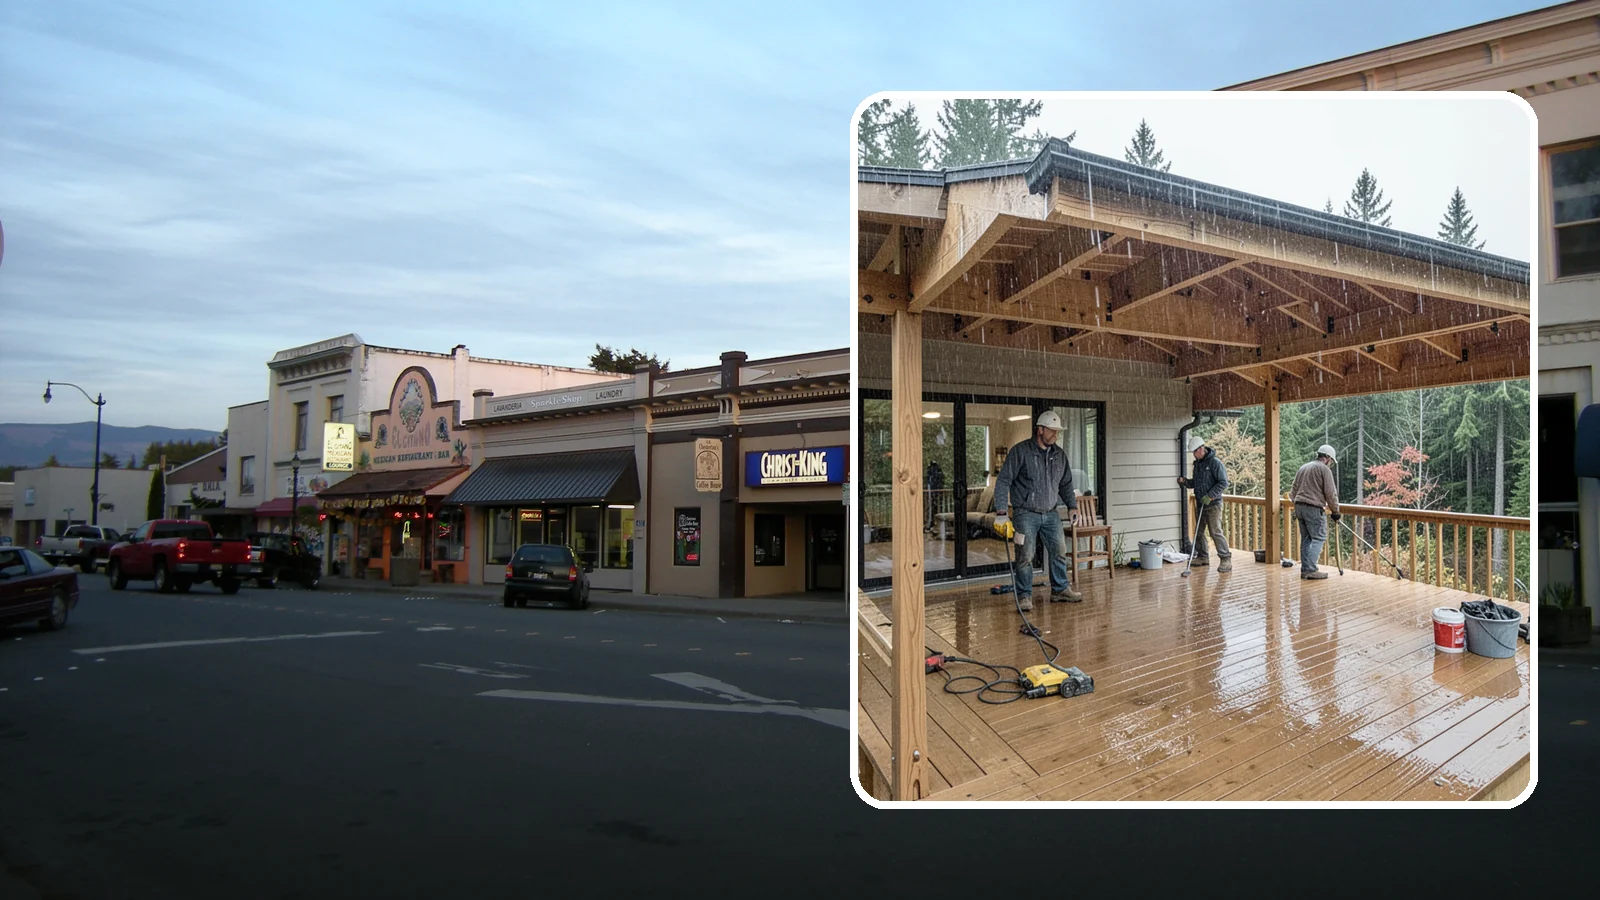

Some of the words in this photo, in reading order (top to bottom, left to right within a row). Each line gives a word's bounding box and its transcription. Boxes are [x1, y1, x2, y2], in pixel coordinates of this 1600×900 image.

[493, 402, 522, 412] LAVANDERIA
[531, 398, 561, 408] Sparkle
[562, 395, 582, 405] Shop
[595, 389, 623, 400] LAUNDRY
[373, 455, 396, 464] MEXICAN
[398, 452, 433, 462] RESTAURANT
[438, 450, 450, 459] BAR
[761, 452, 797, 478] CHRIST
[799, 450, 828, 477] KING
